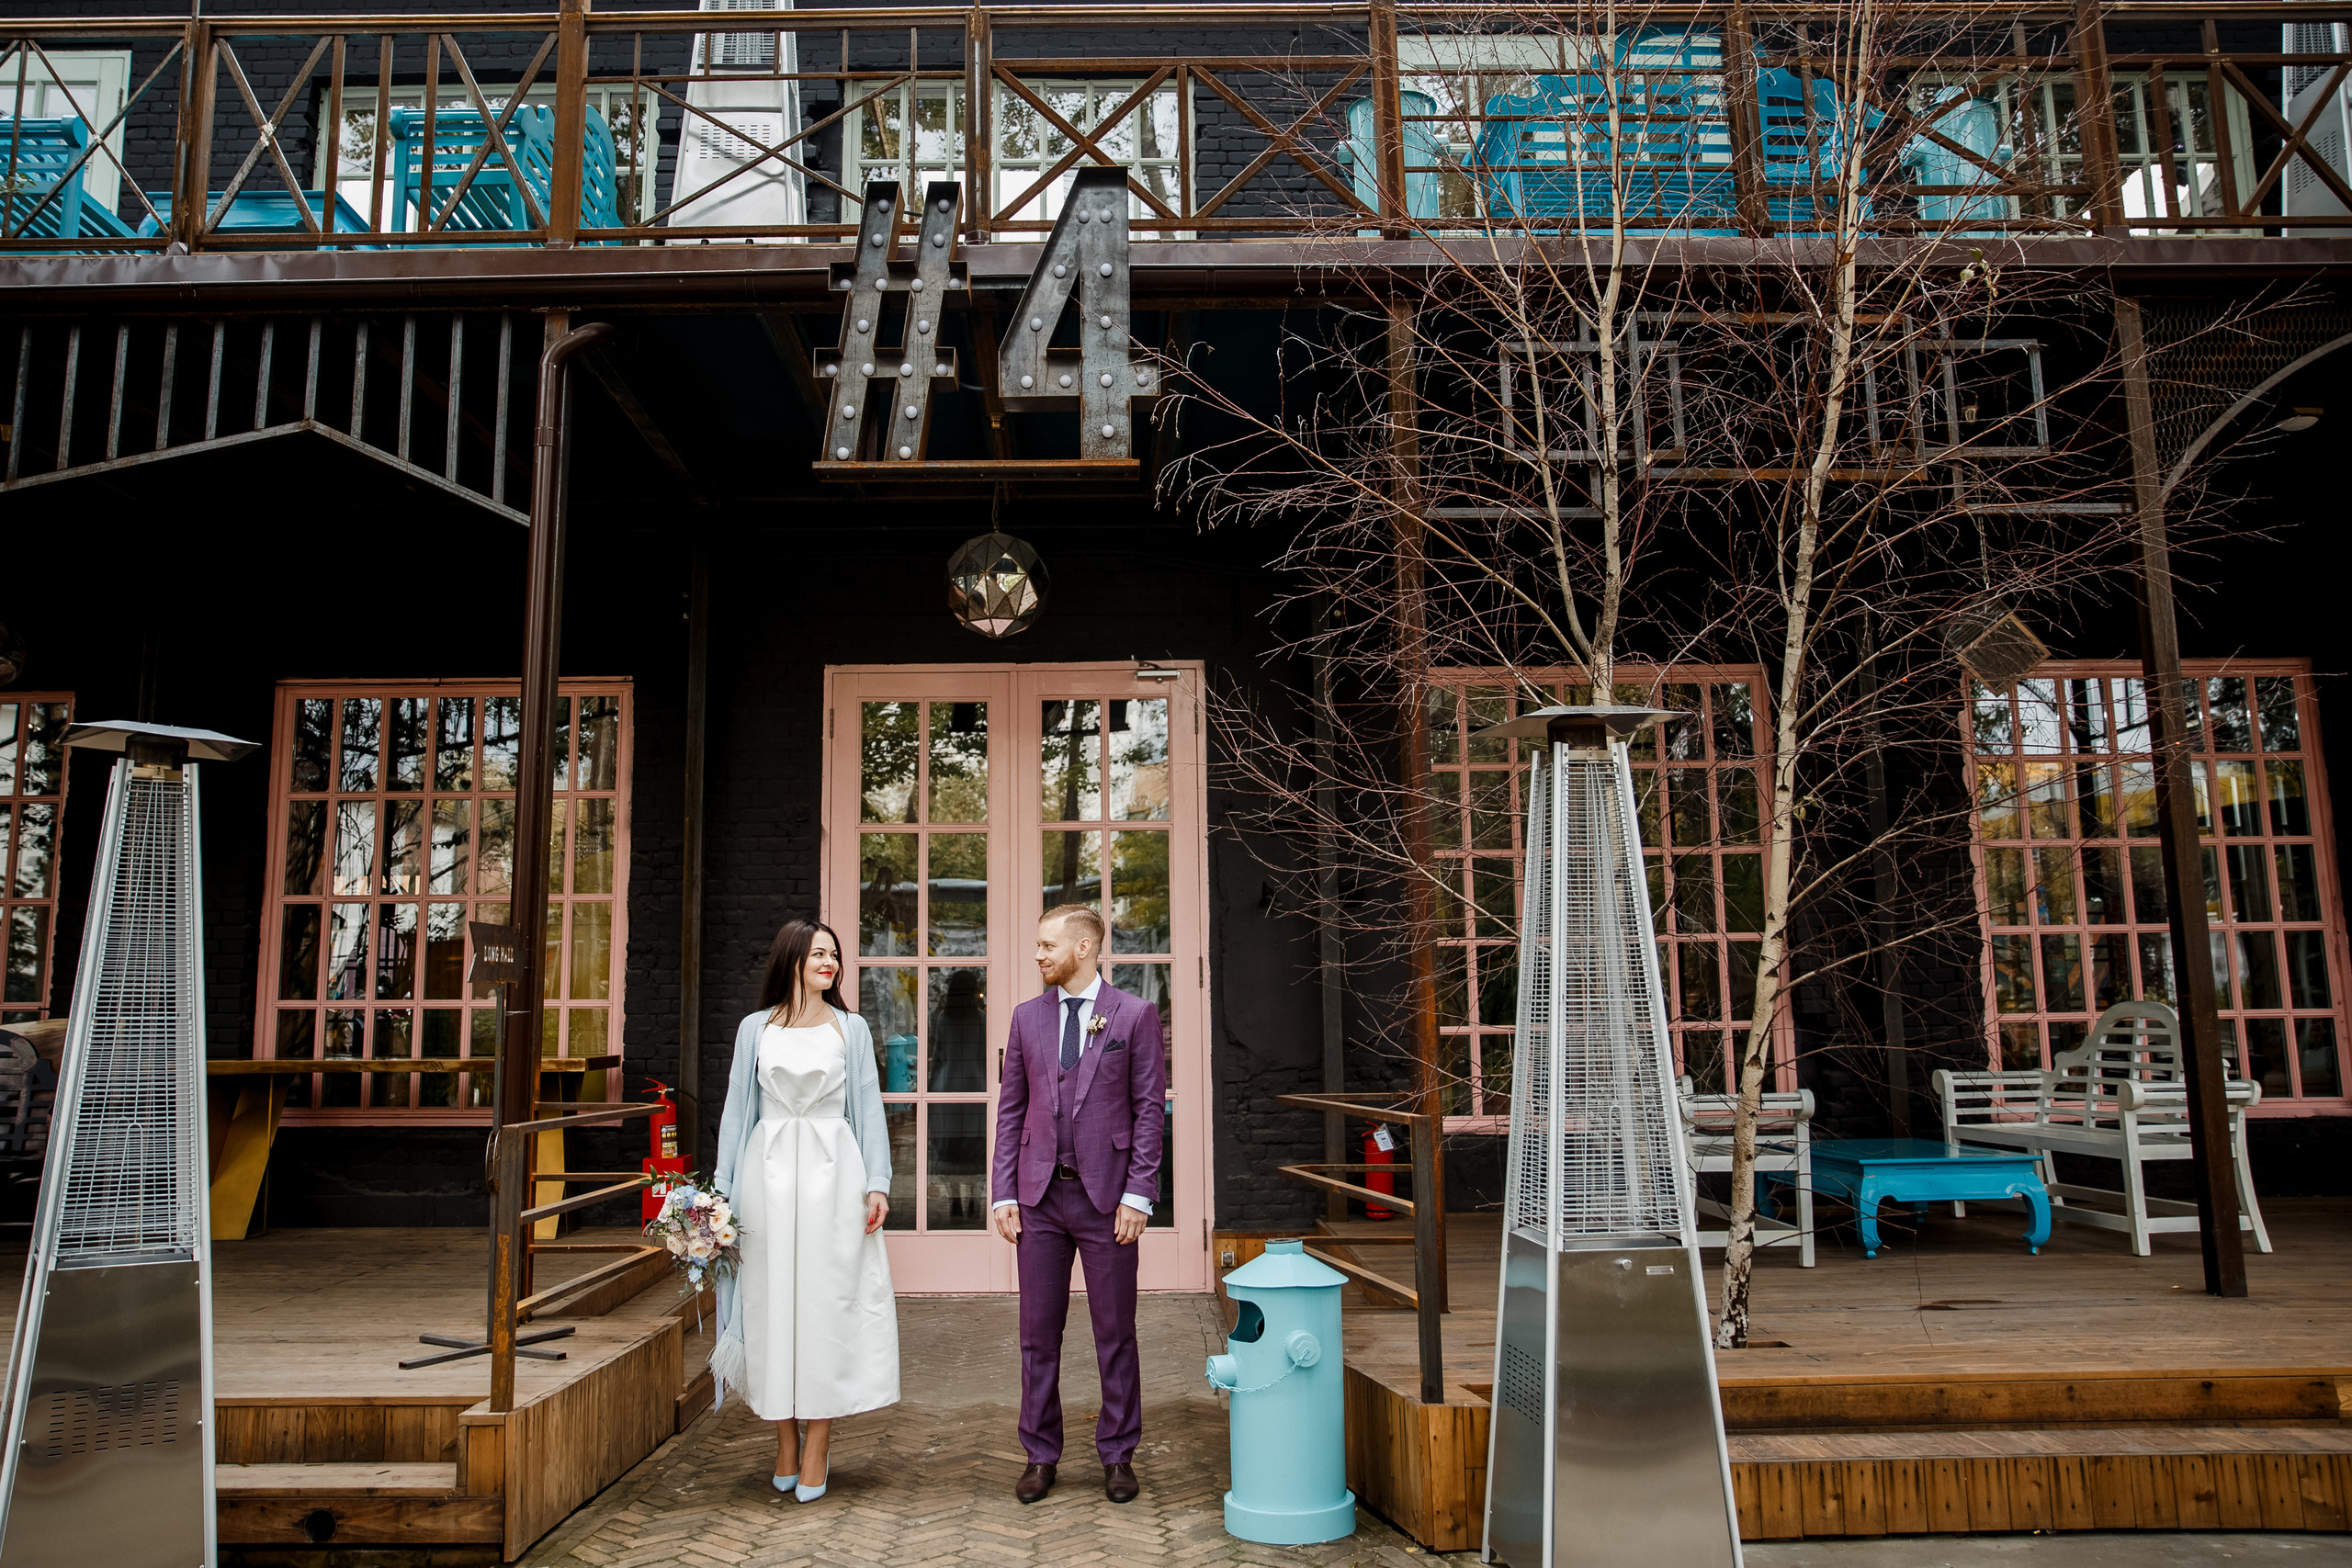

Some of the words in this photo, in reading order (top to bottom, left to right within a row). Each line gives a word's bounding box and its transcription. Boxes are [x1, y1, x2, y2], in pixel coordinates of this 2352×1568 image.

[813, 165, 1160, 461] #4
[483, 945, 499, 962] LONG
[500, 946, 514, 963] HALL
